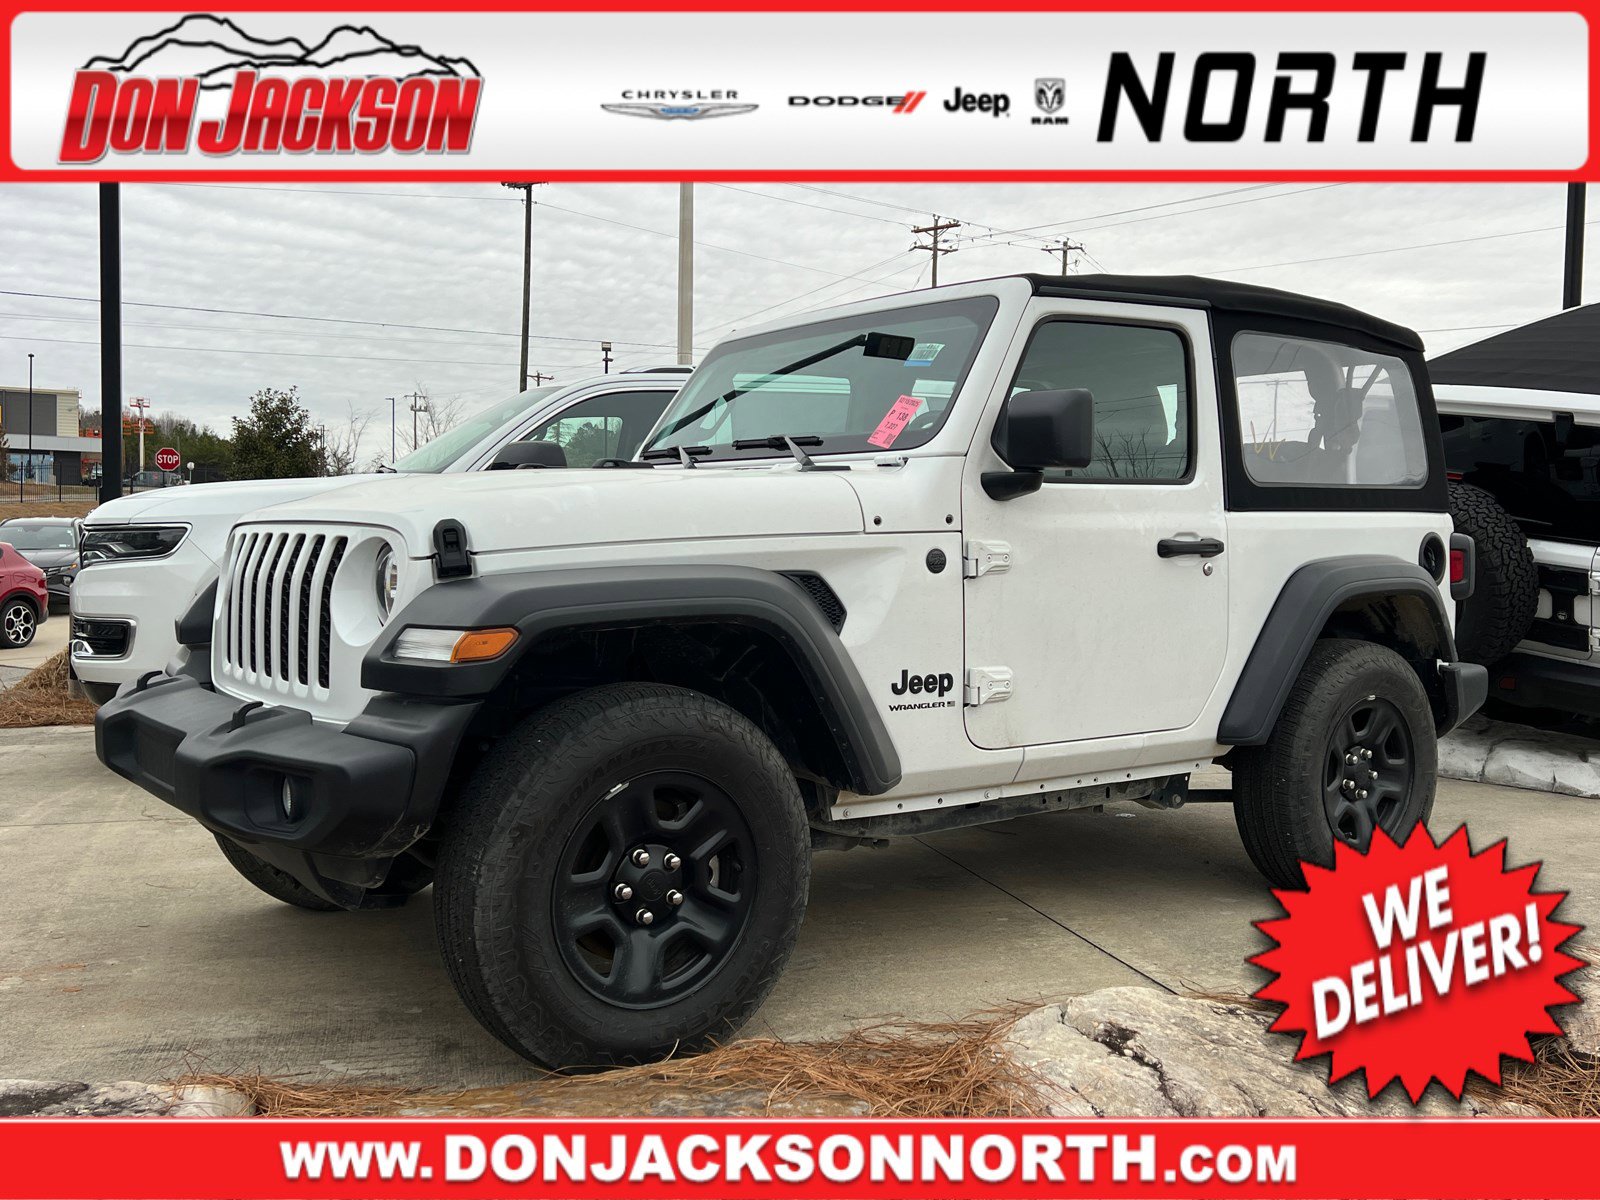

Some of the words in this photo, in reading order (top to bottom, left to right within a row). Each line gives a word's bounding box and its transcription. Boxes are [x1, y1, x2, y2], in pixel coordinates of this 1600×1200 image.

[157, 454, 179, 464] STOP
[891, 669, 954, 698] Jeep
[888, 701, 946, 712] WRANGLER
